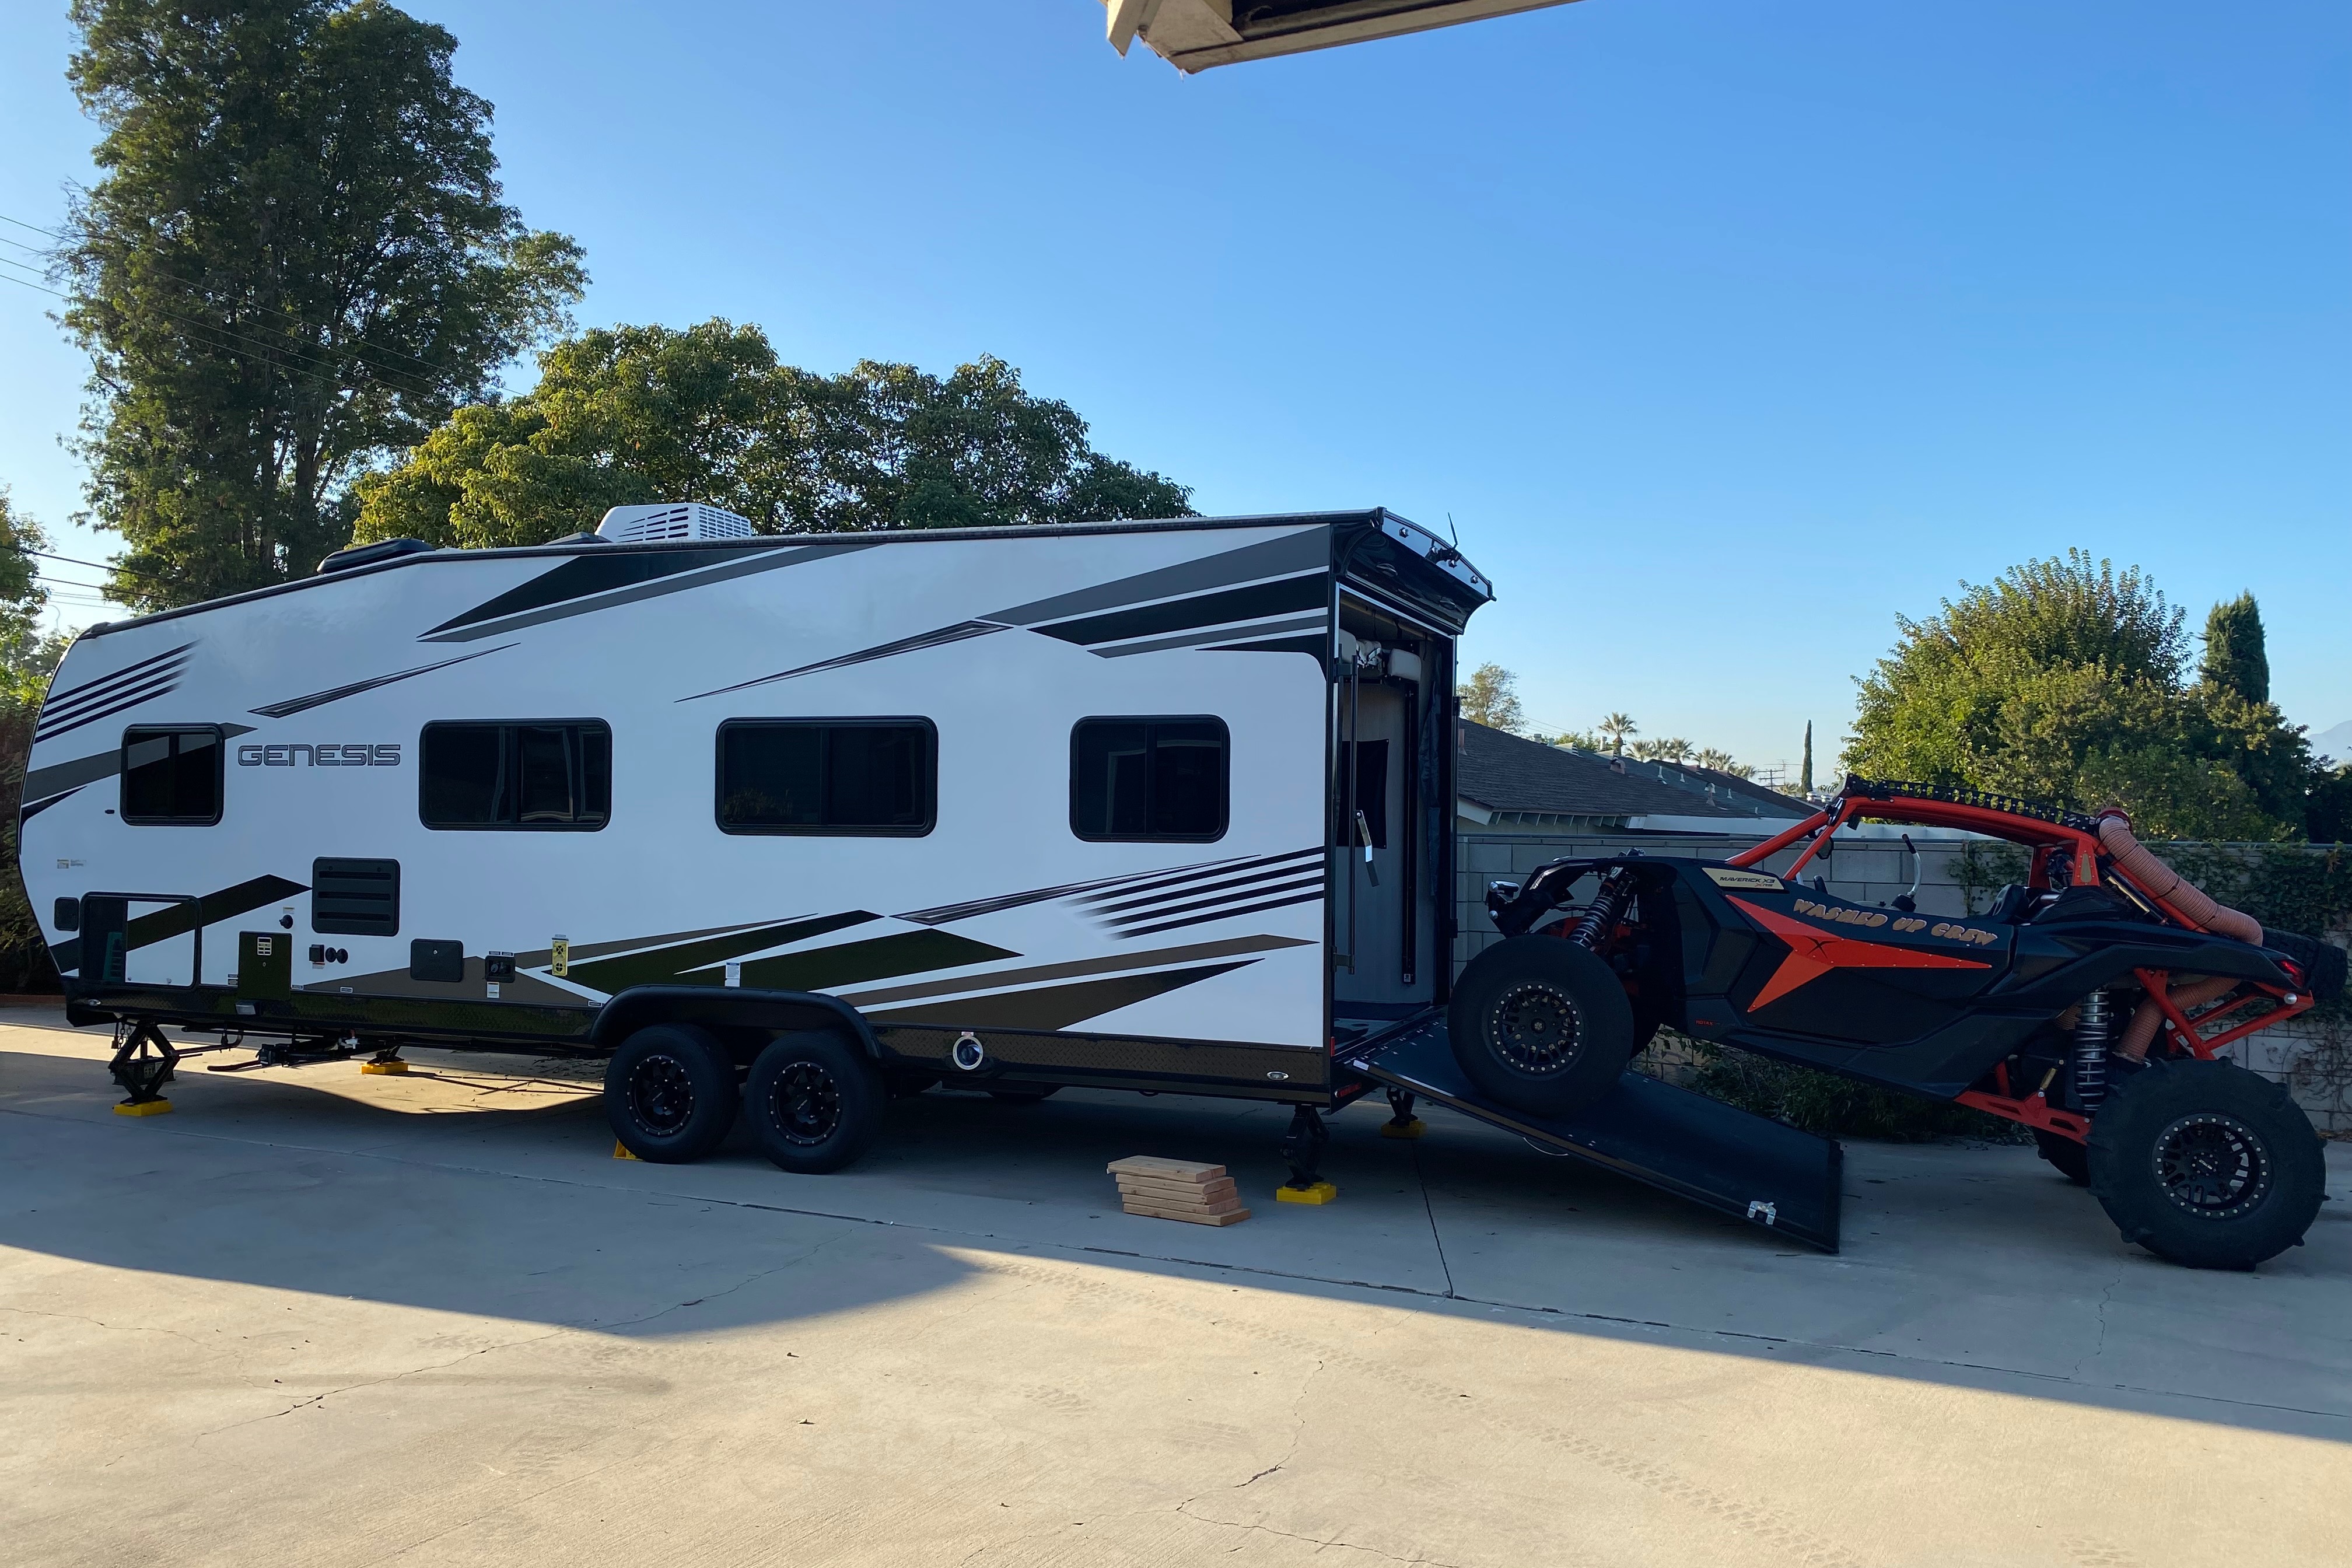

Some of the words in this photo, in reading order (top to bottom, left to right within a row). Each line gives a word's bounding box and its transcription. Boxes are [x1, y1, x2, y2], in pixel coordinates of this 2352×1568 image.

[238, 744, 401, 766] GENESIS
[1793, 899, 1888, 928] WASHED
[1892, 917, 1927, 932] UP
[1931, 923, 1998, 946] CREW
